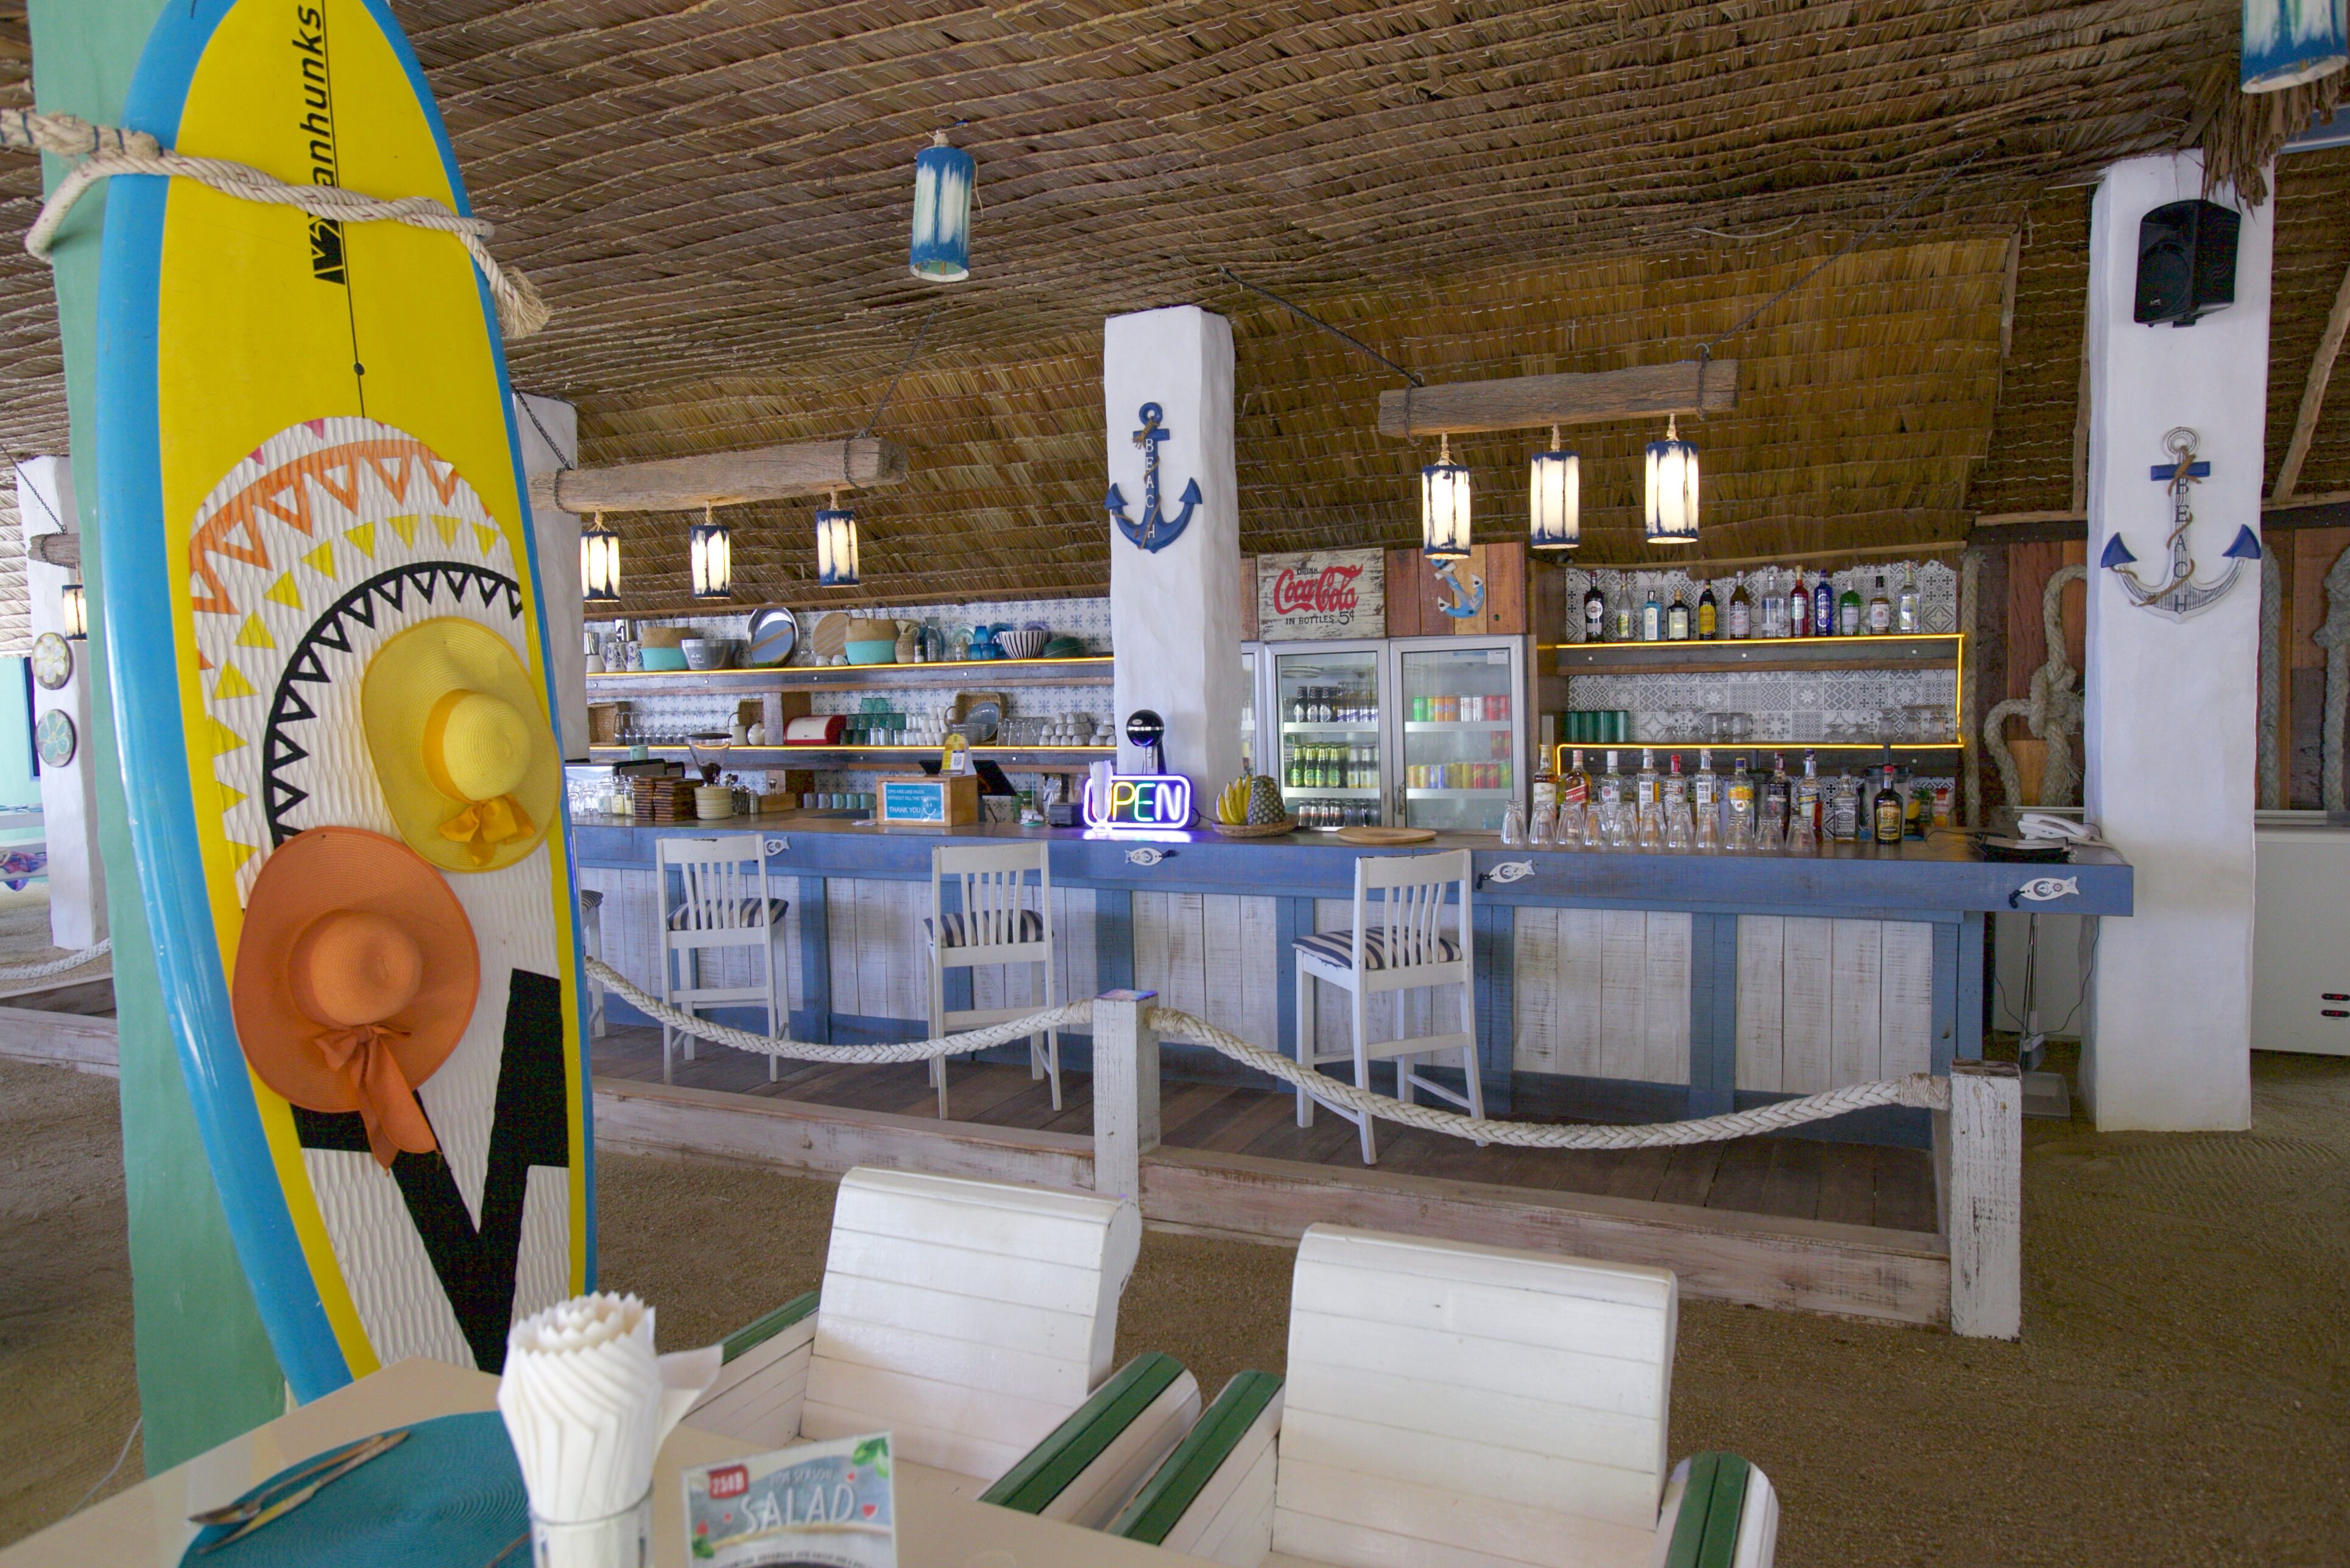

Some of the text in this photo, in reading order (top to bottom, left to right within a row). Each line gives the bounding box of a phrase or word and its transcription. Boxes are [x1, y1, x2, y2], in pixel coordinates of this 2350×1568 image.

[1145, 439, 1156, 539] BEACH
[2173, 477, 2189, 612] BEACH
[1297, 567, 1319, 576] DRINK
[1299, 615, 1335, 624] BOTTLES
[740, 1483, 855, 1534] SALAD
